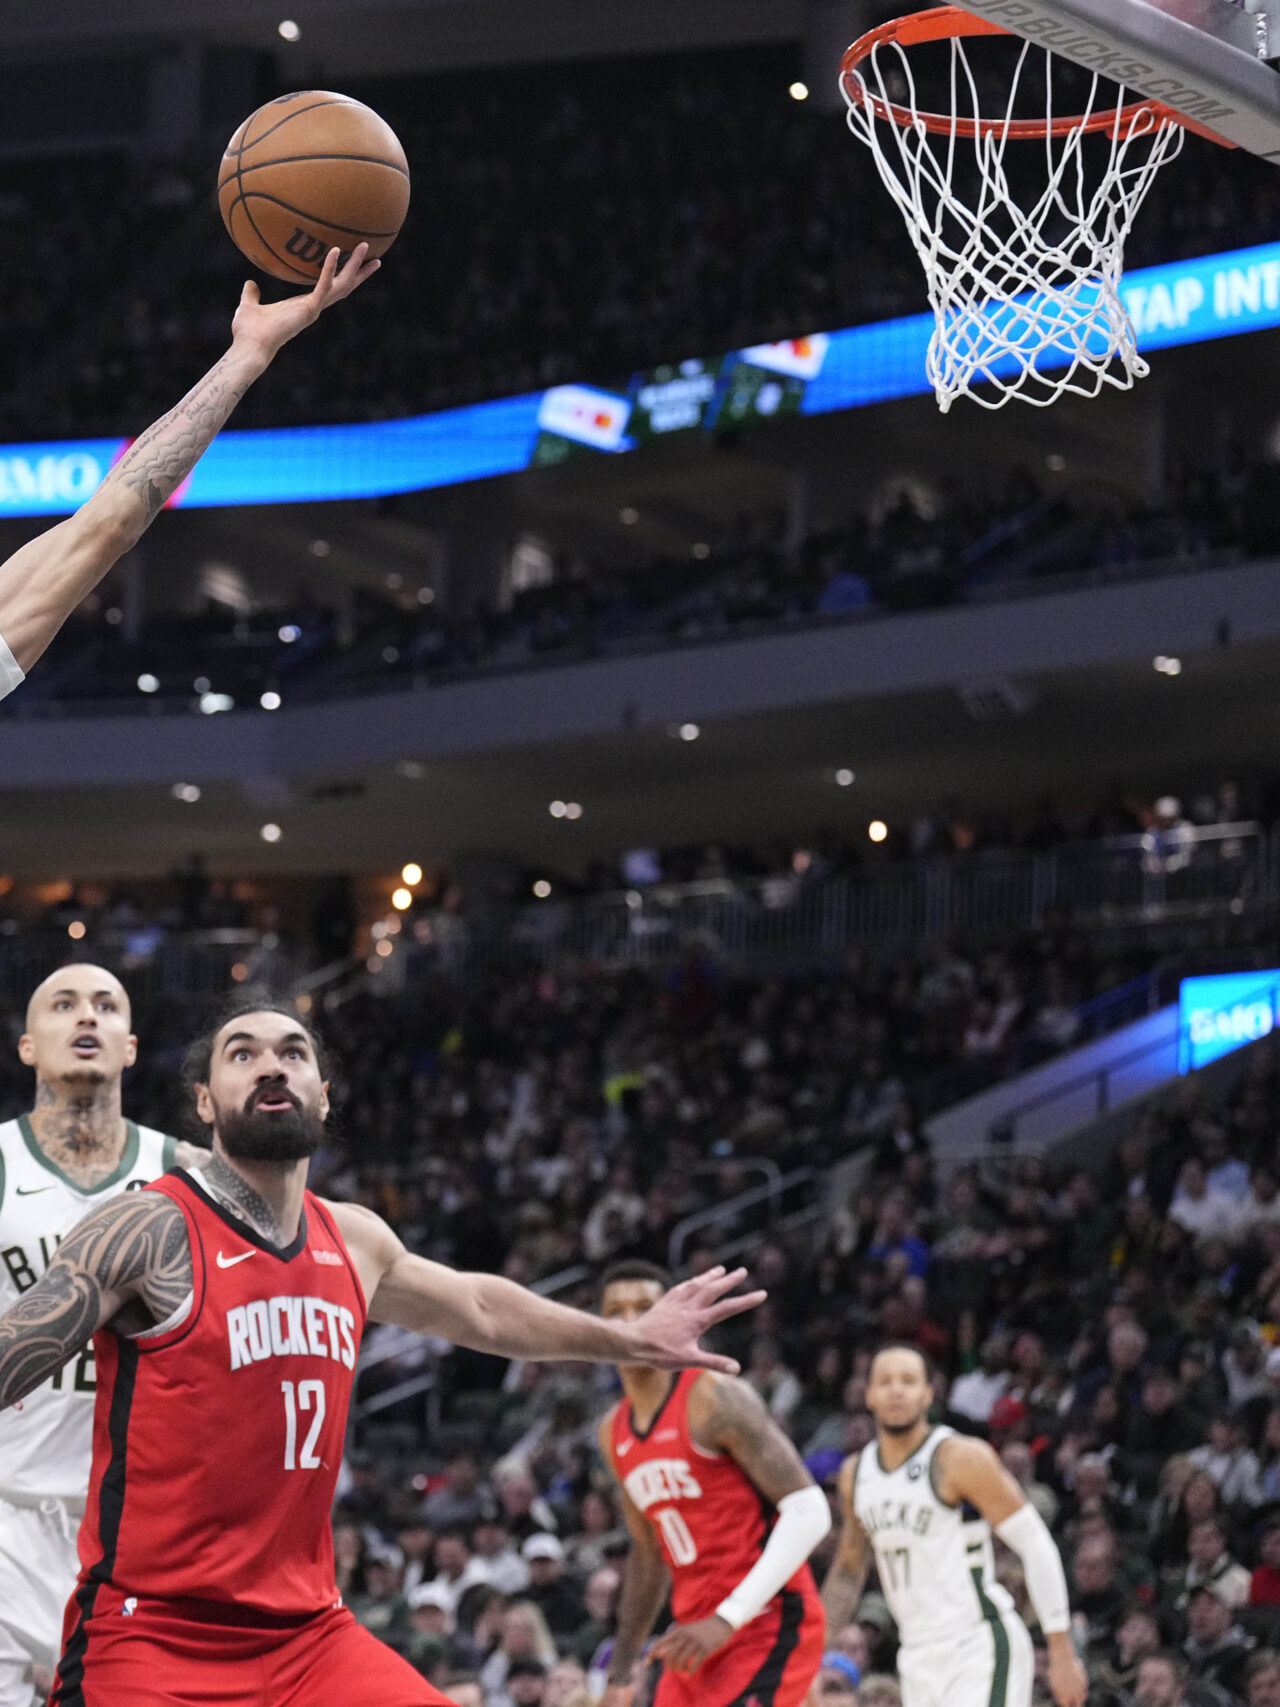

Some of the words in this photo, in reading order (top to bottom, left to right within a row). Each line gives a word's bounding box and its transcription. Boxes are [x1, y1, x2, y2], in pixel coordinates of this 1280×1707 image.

[1123, 277, 1204, 333] TAP
[1190, 1001, 1273, 1045] BMO
[226, 1296, 356, 1372] ROCKETS
[281, 1378, 327, 1471] 12
[652, 1506, 698, 1568] 0
[862, 1500, 935, 1537] UCKS
[882, 1547, 912, 1593] 17
